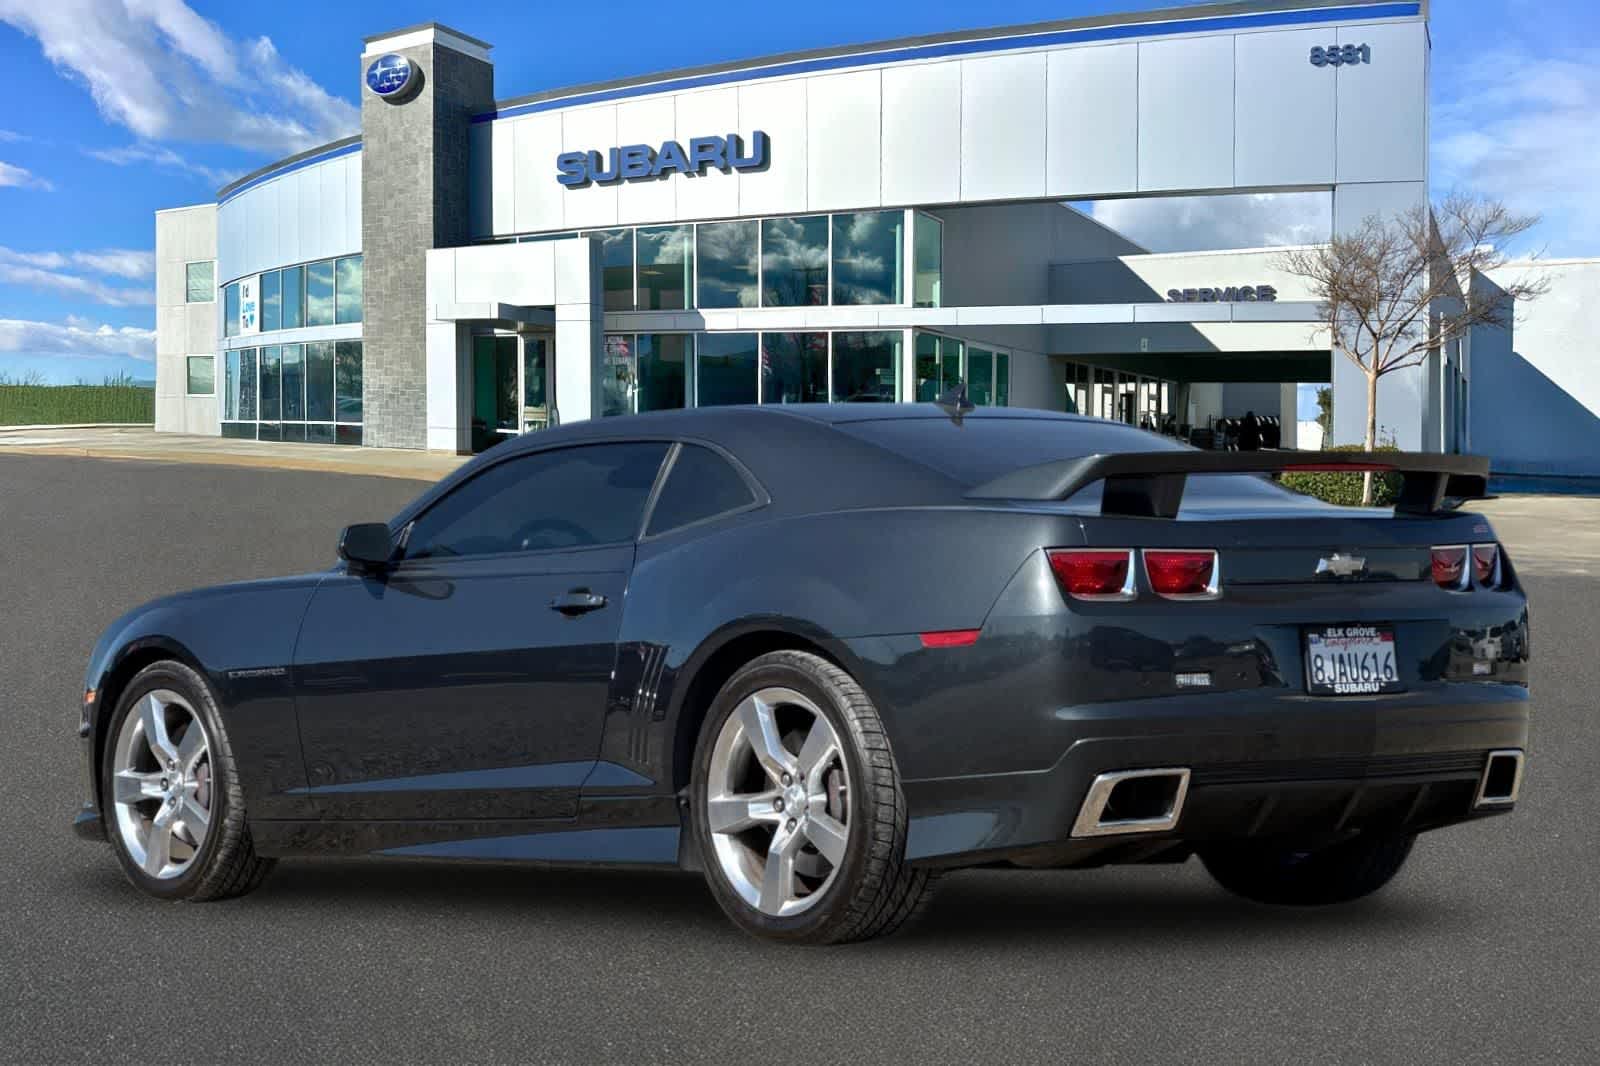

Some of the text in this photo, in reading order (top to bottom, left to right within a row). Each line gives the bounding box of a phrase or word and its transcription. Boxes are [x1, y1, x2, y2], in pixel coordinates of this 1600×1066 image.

[556, 130, 771, 190] SUBARU
[1167, 285, 1277, 302] SERVICE
[1327, 627, 1377, 638] ELK GROVE
[1313, 651, 1394, 683] 8JAU616
[1334, 682, 1380, 693] SUBARU
